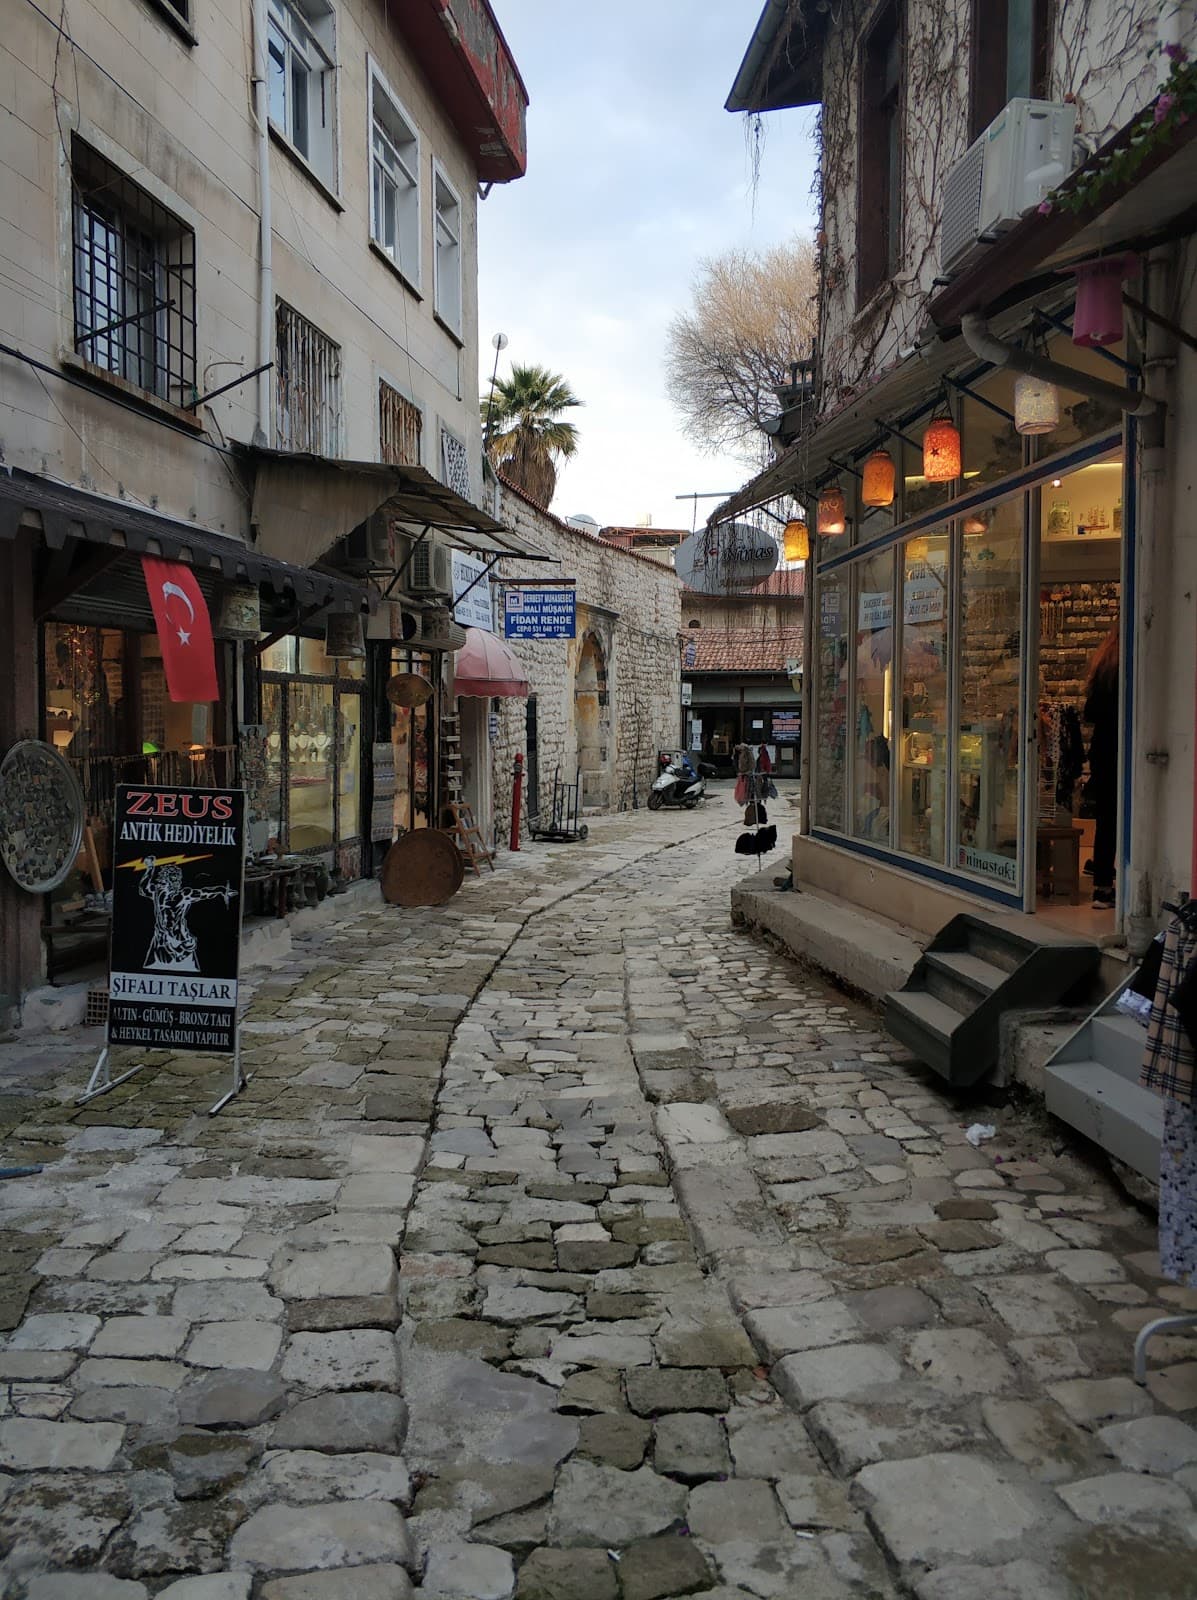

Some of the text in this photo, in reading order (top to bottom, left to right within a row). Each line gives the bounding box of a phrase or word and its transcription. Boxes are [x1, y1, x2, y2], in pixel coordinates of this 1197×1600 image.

[511, 614, 572, 624] FİDAN RENDE
[542, 604, 574, 614] MÜŞAVİR
[126, 791, 232, 819] ZEUS
[120, 818, 236, 845] ANTİK HEDİYELİK
[112, 975, 231, 1001] ŞİFALI TAŞLAR
[143, 1007, 174, 1026] GÜMÜŞ
[179, 1011, 210, 1026] BRONZ
[210, 1014, 231, 1027] TAKI
[119, 1027, 153, 1041] HEYKEL
[153, 1029, 195, 1043] TASARIMI
[195, 1031, 230, 1046] YAPILIR
